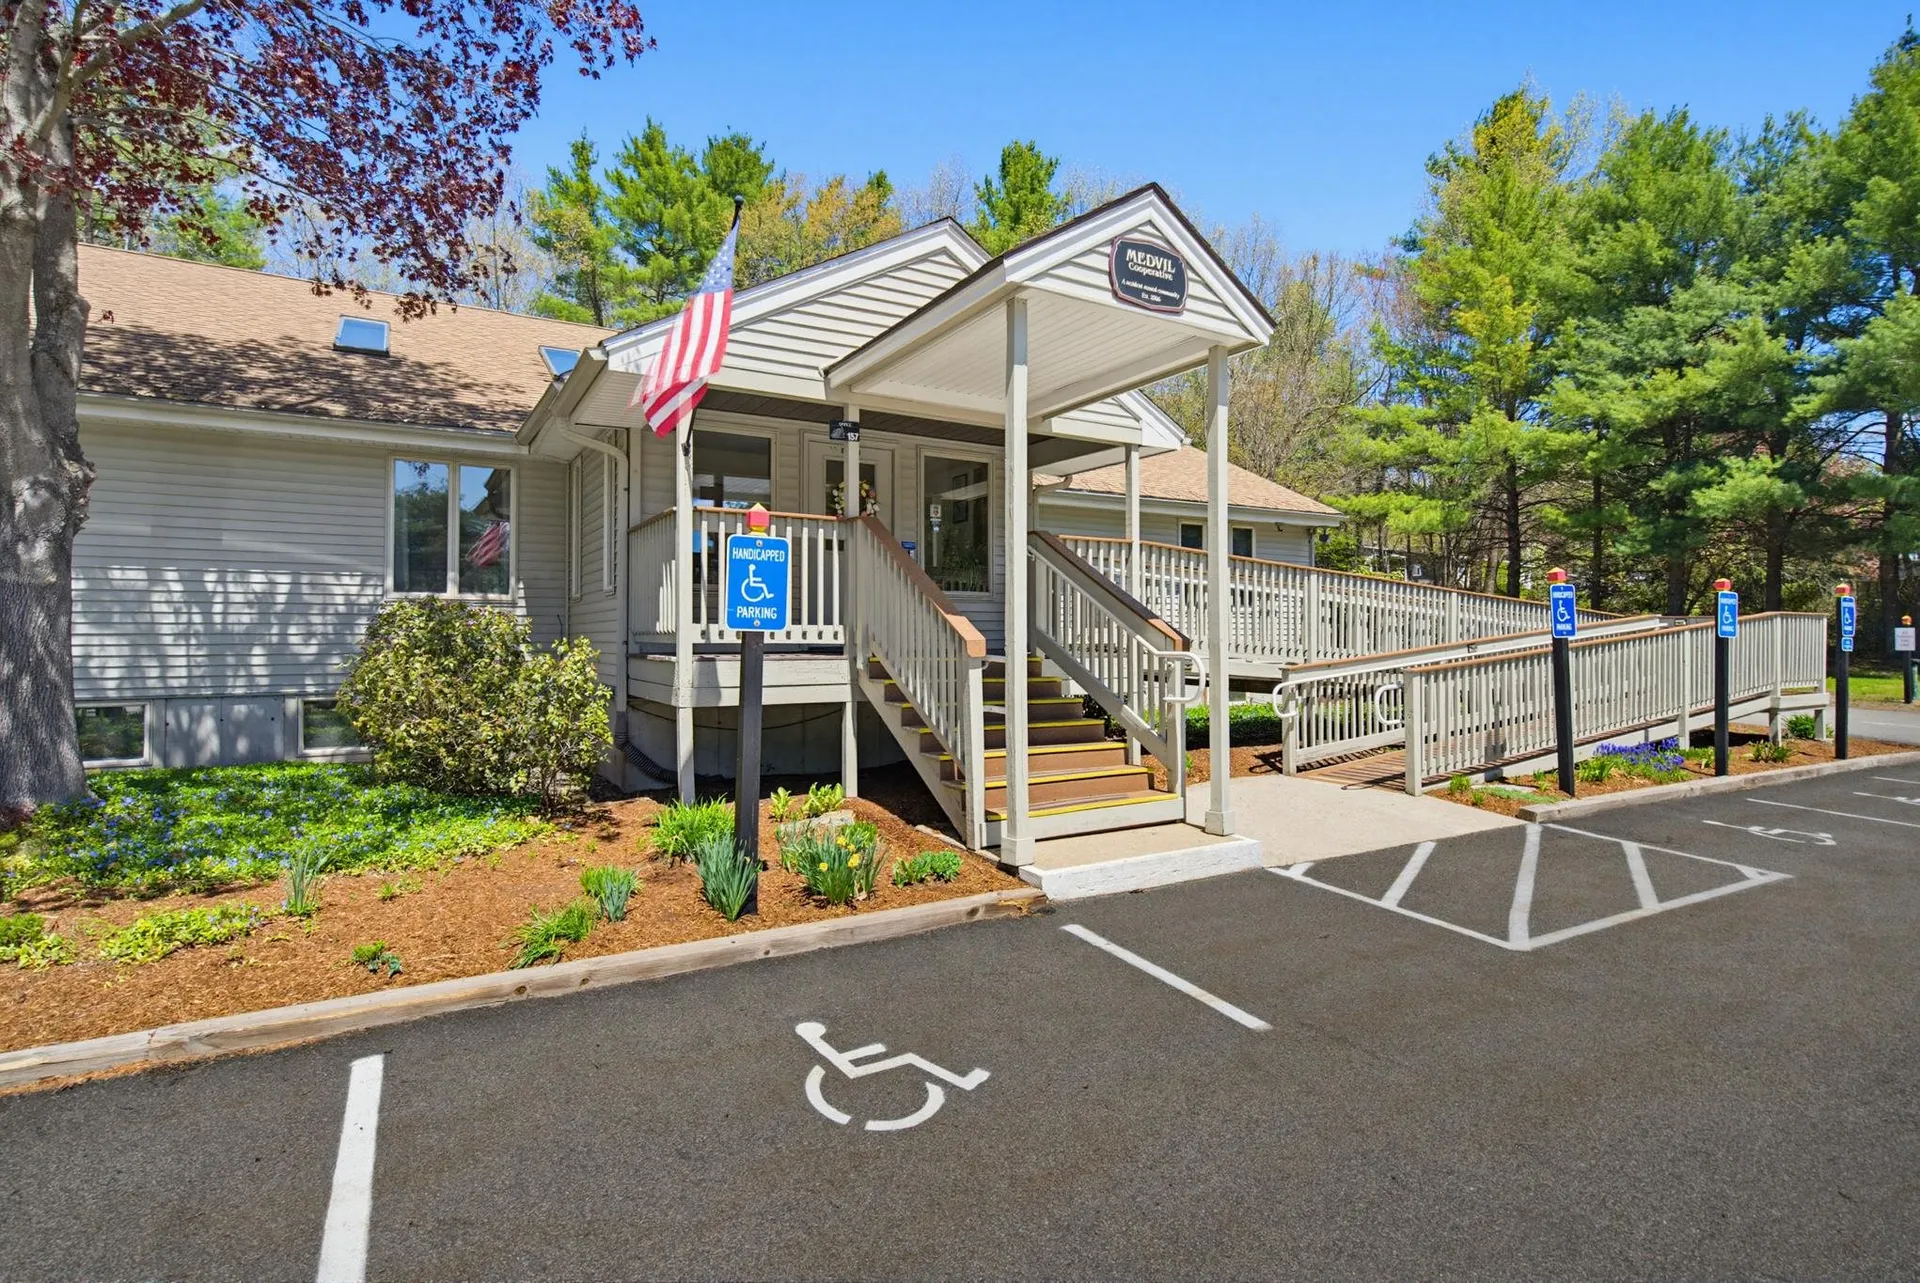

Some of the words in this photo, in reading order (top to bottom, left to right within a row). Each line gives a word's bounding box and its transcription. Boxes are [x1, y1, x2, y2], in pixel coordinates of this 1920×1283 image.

[1126, 249, 1176, 273] MEDVIL
[1128, 262, 1173, 281] Cooperative
[847, 432, 859, 441] 157
[732, 547, 785, 563] HANDICAPPED
[737, 606, 777, 620] PARKING
